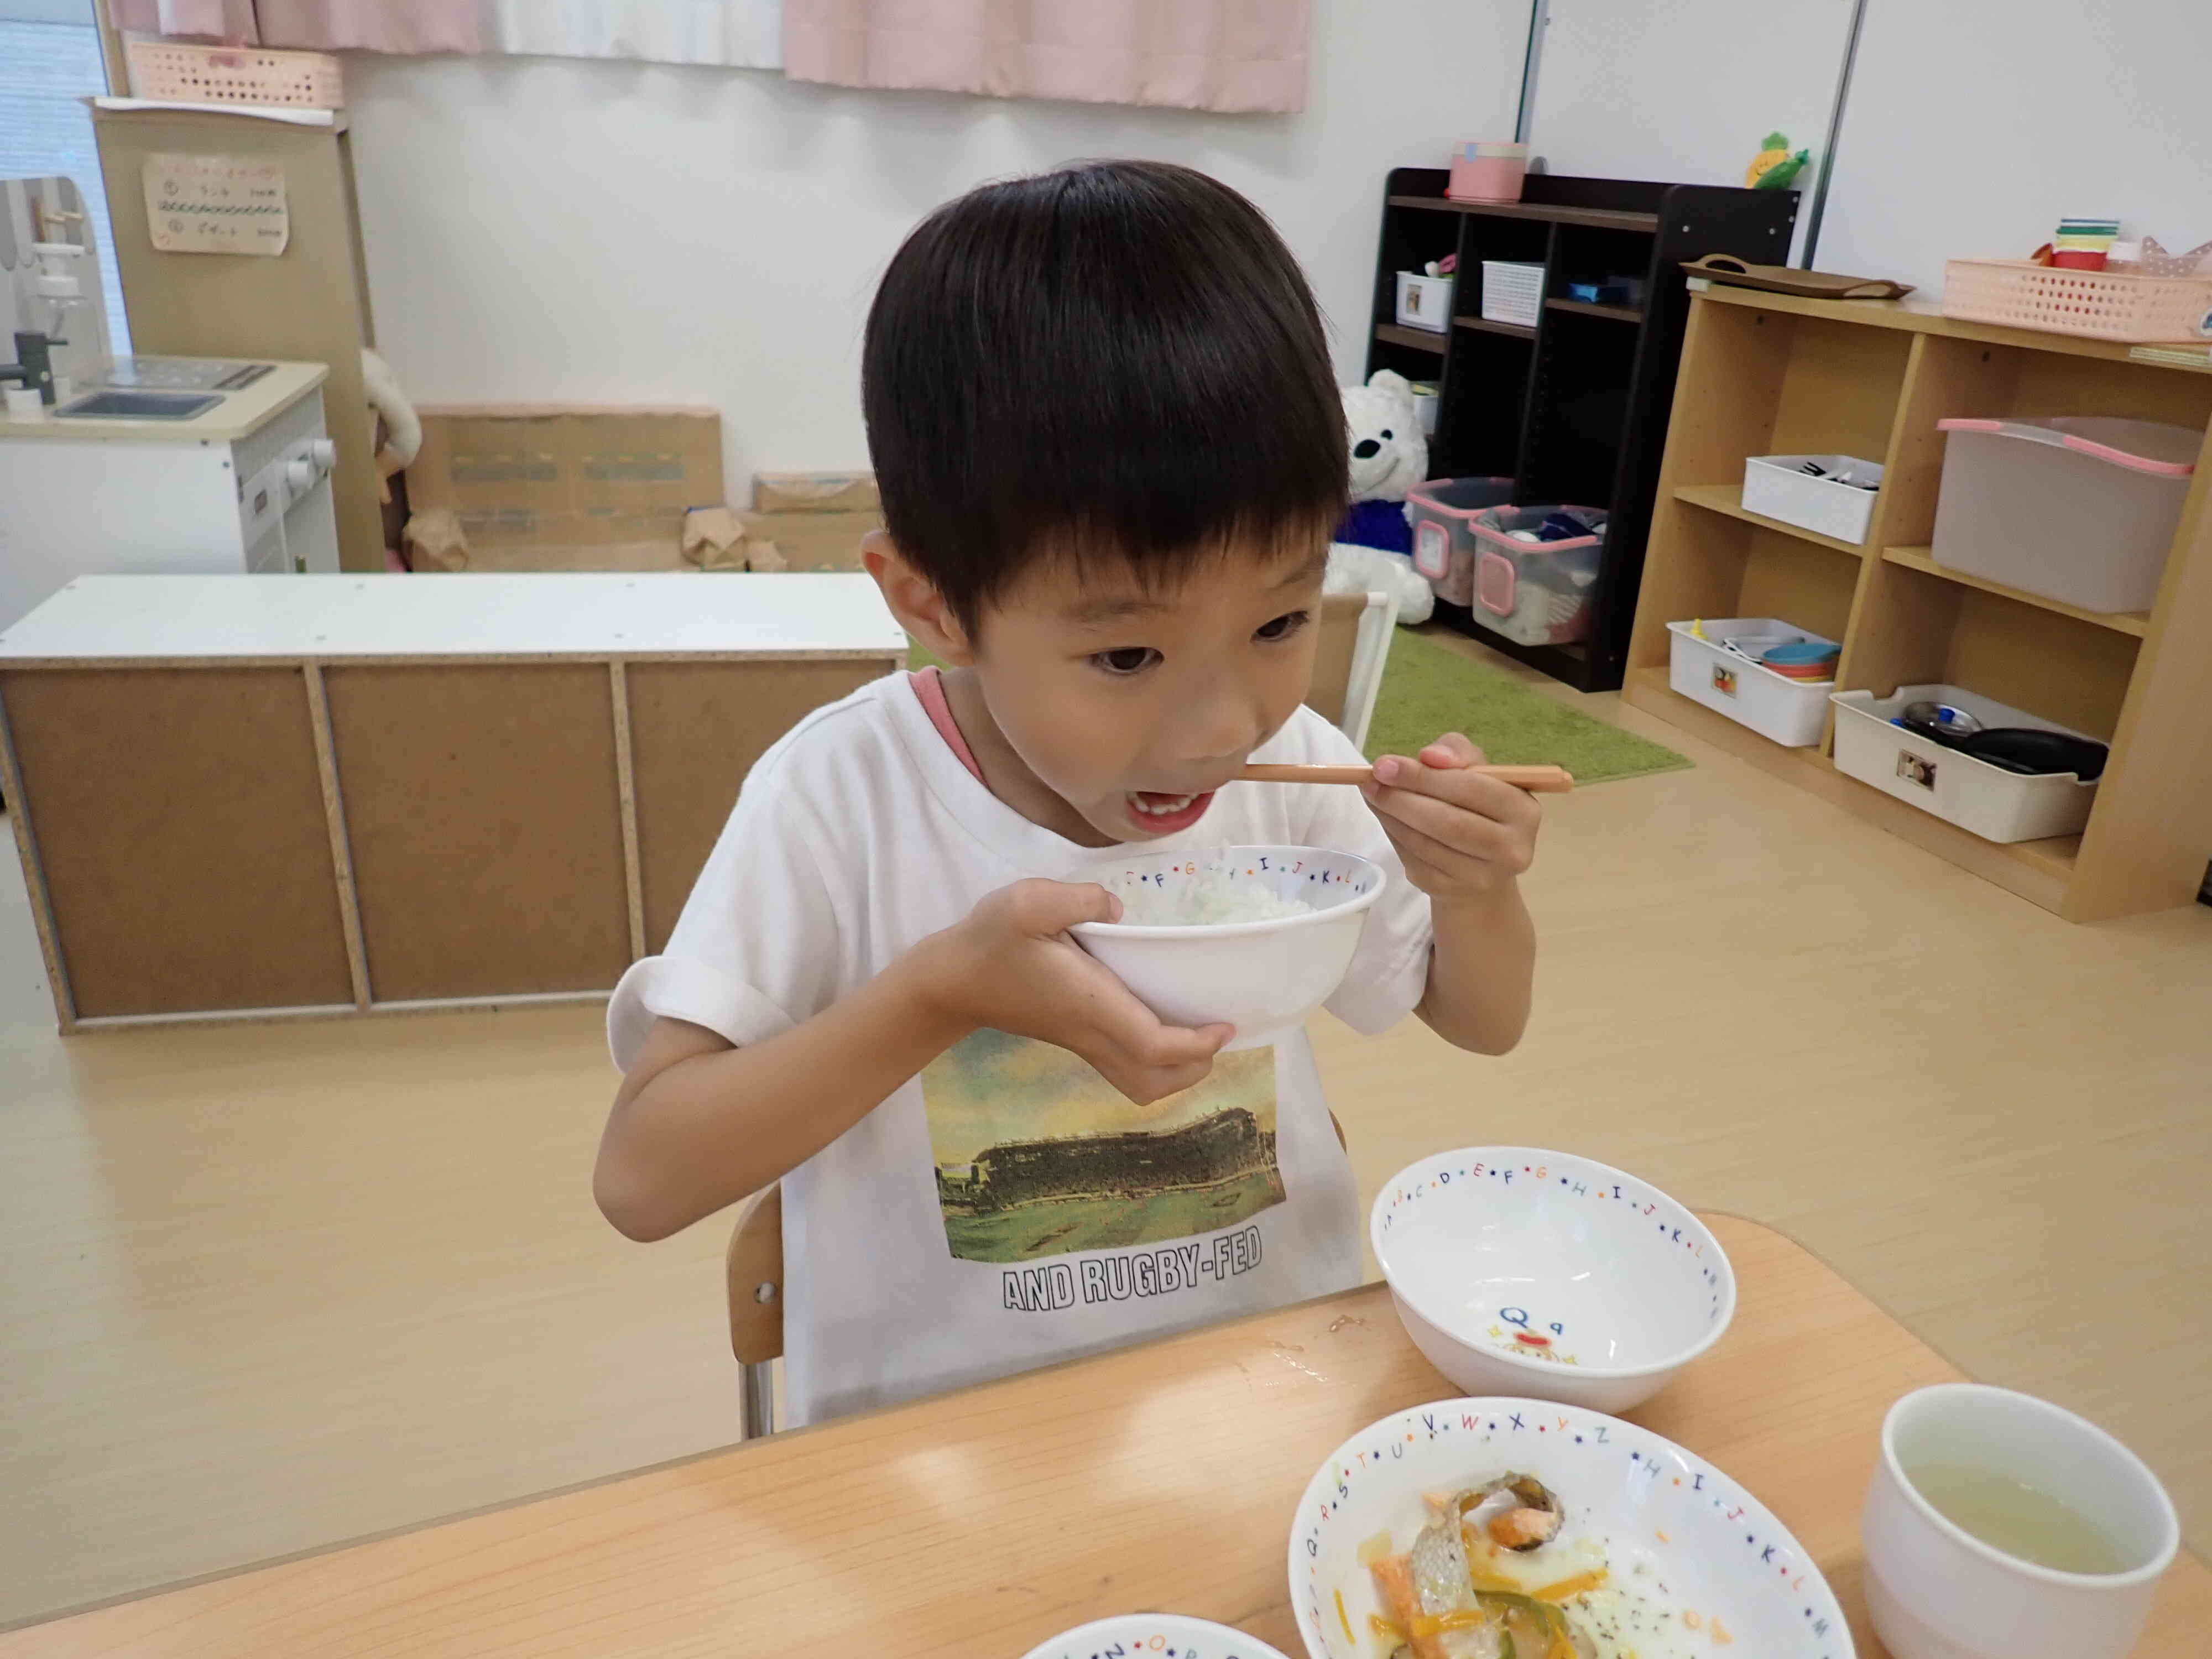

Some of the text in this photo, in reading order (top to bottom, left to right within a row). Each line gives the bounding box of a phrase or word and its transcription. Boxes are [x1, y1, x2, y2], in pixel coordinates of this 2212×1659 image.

[1155, 873, 1164, 888] F
[1185, 862, 1195, 875] G
[1259, 857, 1269, 870] I
[1292, 861, 1303, 874] J
[1322, 870, 1329, 884] K
[1439, 1172, 1450, 1184] D
[1473, 1163, 1484, 1177] E
[1504, 1170, 1513, 1185] F
[1536, 1166, 1547, 1179] G
[1571, 1182, 1587, 1197] H
[1612, 1186, 1621, 1199] I
[1643, 1203, 1656, 1215] J
[1672, 1228, 1681, 1243] K
[1003, 1225, 1262, 1311] AND RUGBY-FED
[1499, 1307, 1528, 1329] Q
[1320, 1504, 1329, 1521] R
[1338, 1482, 1348, 1499] S
[1356, 1452, 1366, 1468] T
[1391, 1442, 1402, 1459] U
[1422, 1414, 1433, 1431] V
[1461, 1413, 1479, 1431] W
[1509, 1412, 1525, 1431] X
[1595, 1426, 1610, 1443] Z
[1643, 1459, 1661, 1478] H
[1693, 1473, 1704, 1490] I
[1727, 1506, 1744, 1519] J
[1761, 1544, 1776, 1564] K
